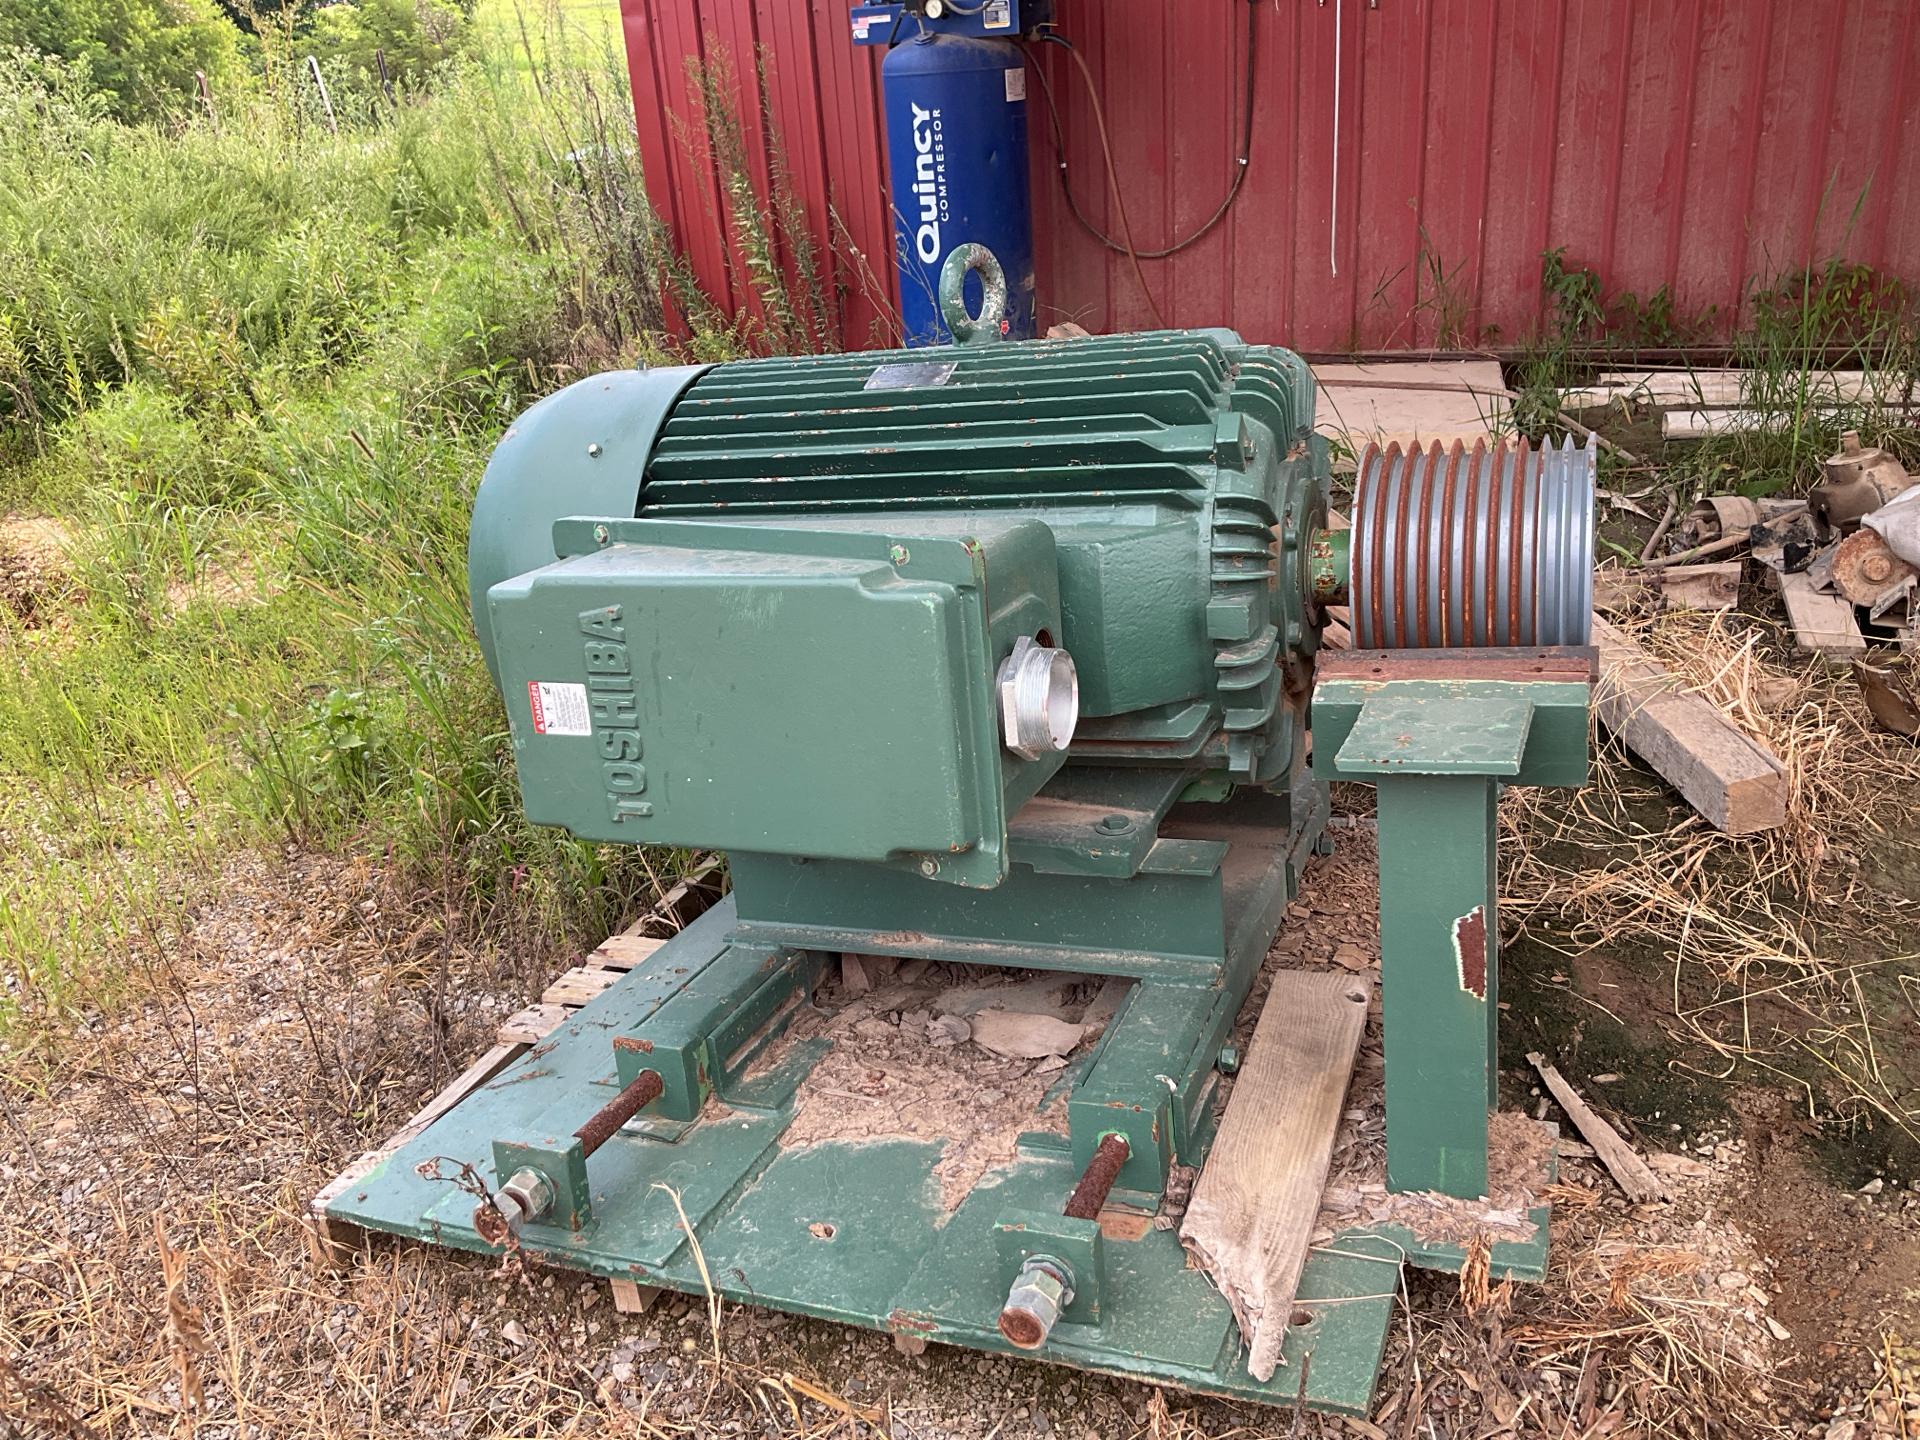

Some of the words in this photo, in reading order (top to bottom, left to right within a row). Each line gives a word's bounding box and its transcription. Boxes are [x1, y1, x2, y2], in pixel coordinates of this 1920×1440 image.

[932, 109, 949, 222] COMPRESSOR
[531, 684, 544, 722] DANGER
[578, 603, 653, 823] TOSHIBA
